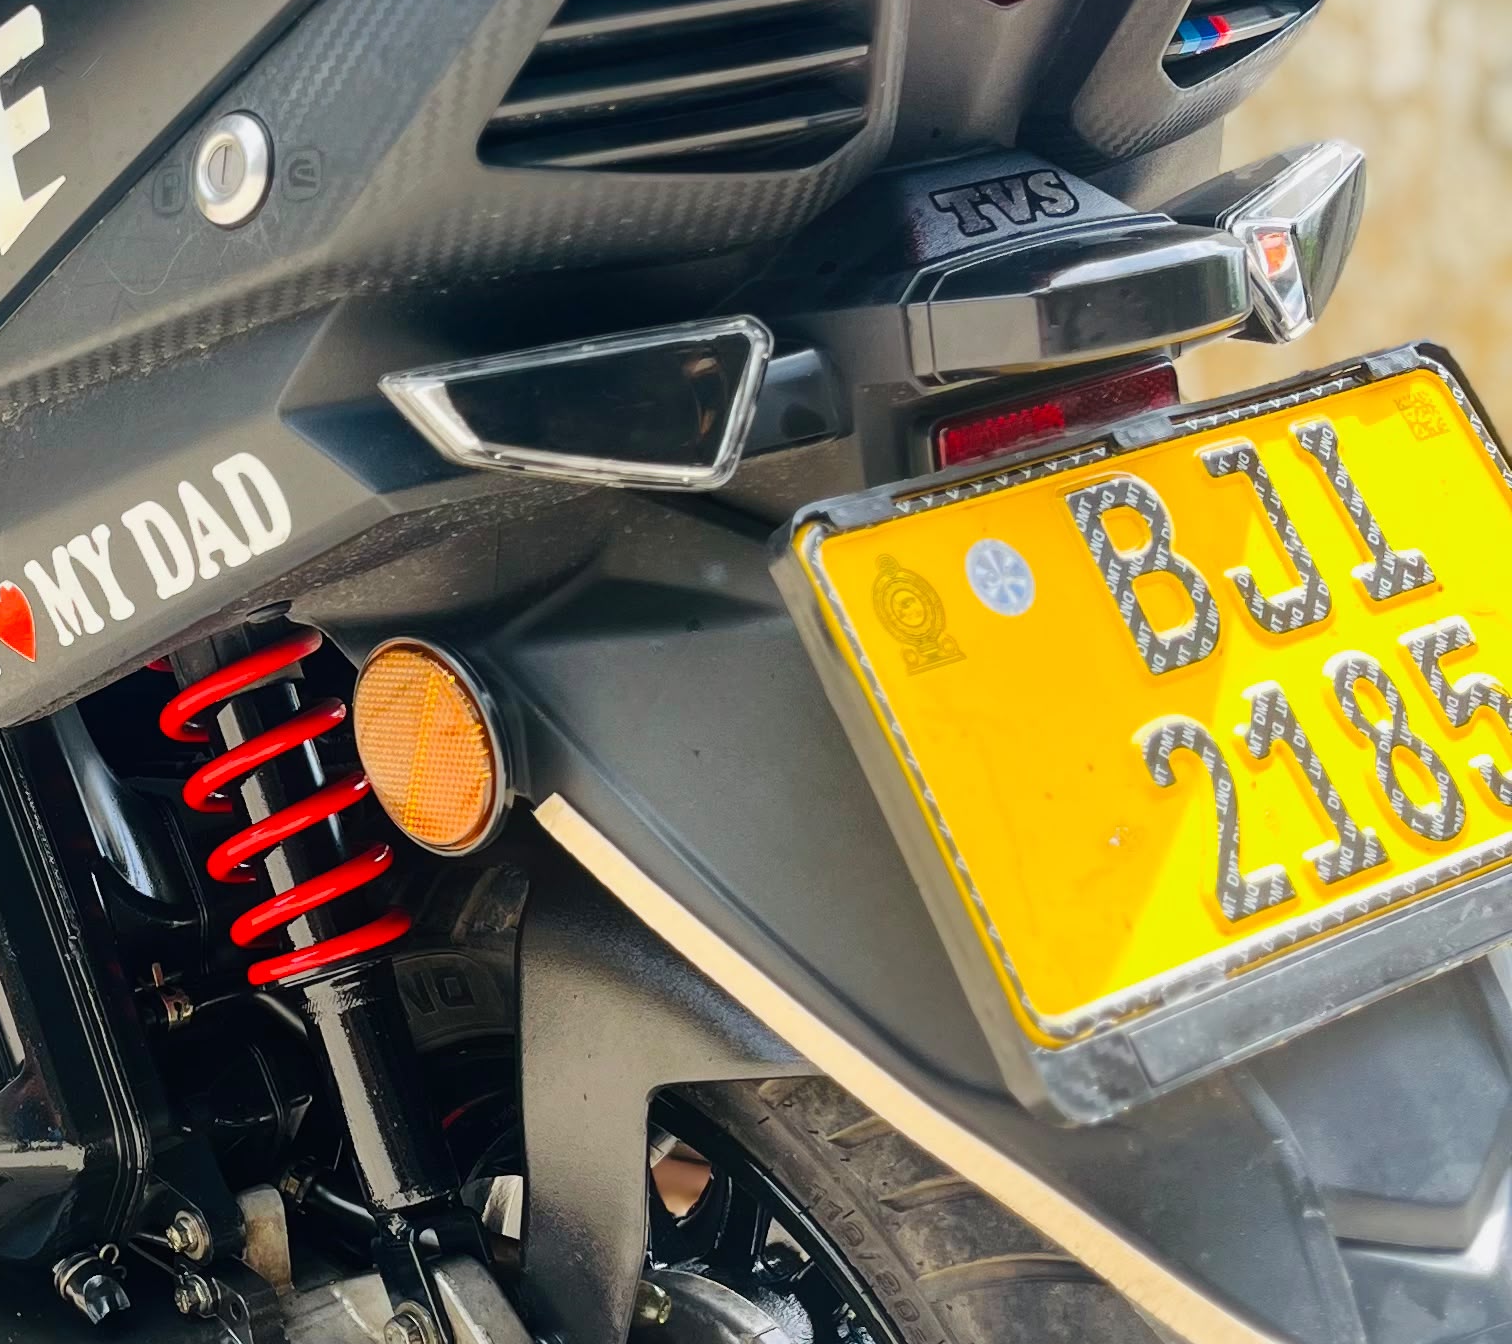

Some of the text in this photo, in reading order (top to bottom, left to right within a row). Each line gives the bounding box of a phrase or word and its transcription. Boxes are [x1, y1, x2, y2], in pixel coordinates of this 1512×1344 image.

[929, 169, 1080, 237] TVS
[24, 524, 136, 647] MY
[121, 452, 293, 600] DAD
[1061, 419, 1439, 676] BJI
[1134, 614, 1512, 924] 2185
